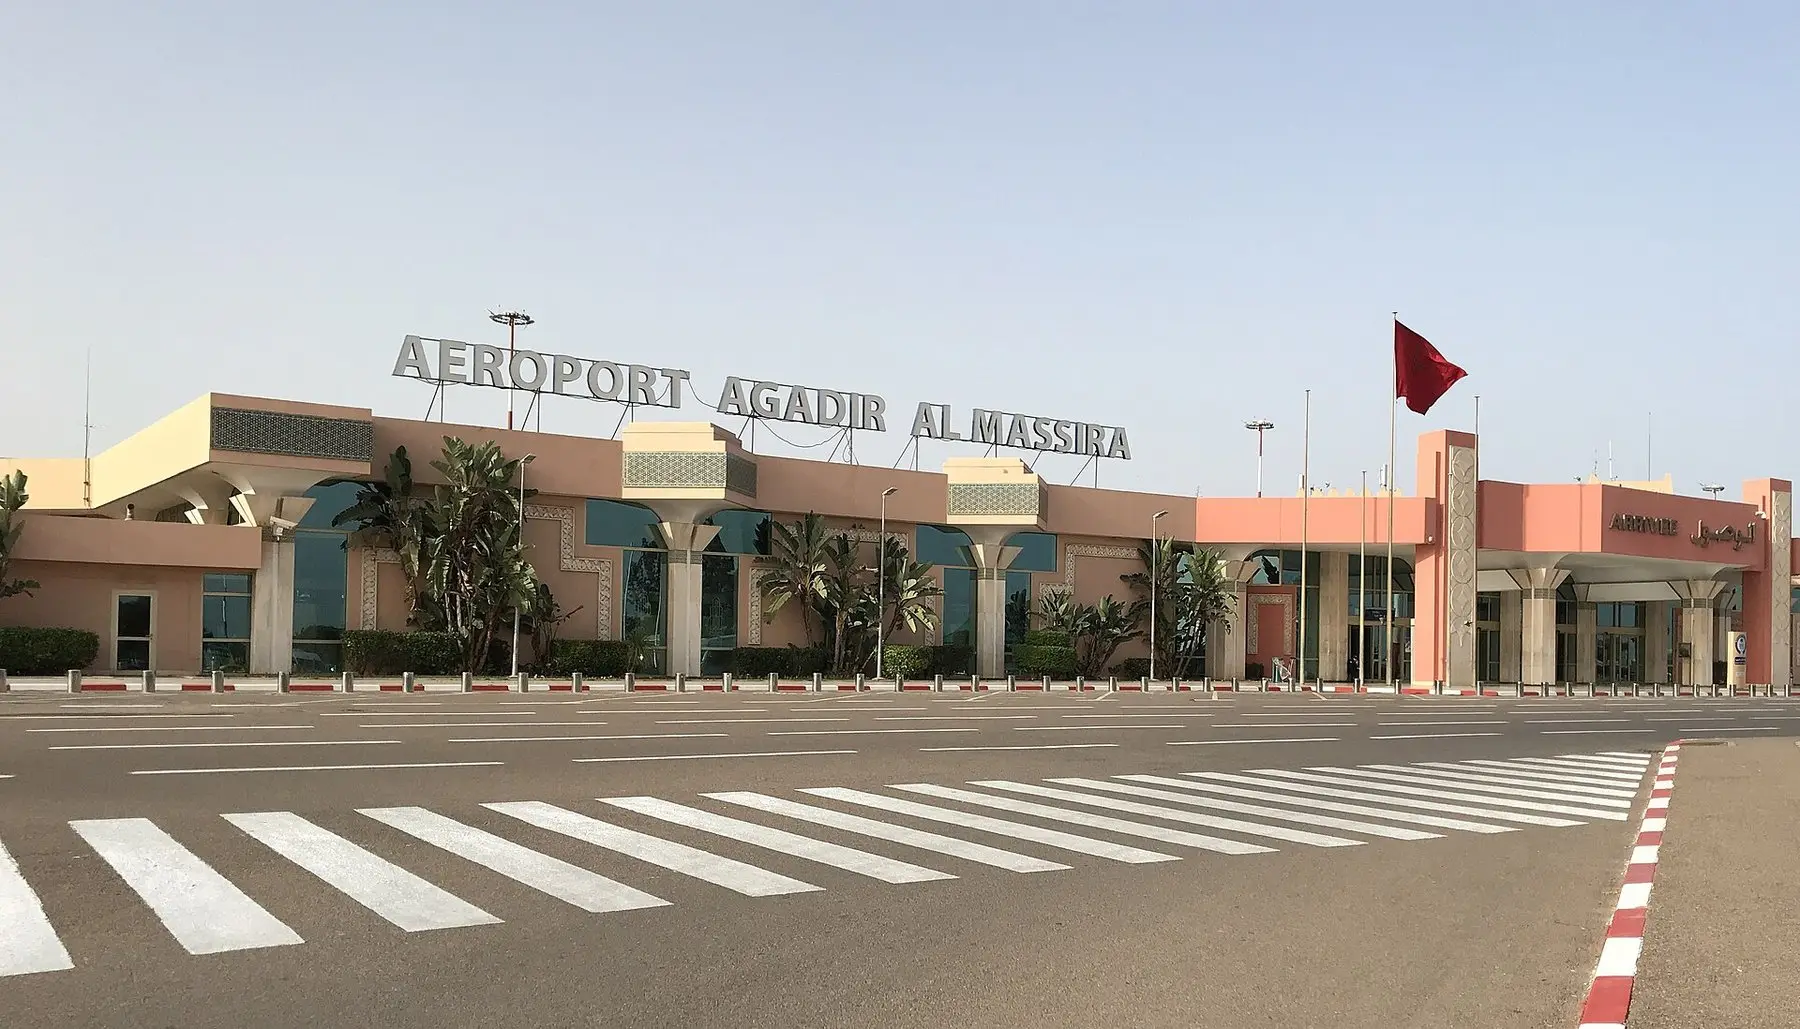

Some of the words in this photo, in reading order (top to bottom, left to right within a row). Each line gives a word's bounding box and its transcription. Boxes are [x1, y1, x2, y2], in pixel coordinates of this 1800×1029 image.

[392, 335, 690, 408] AEROPORT
[717, 376, 886, 432] AGADIR
[911, 402, 961, 439] AL
[971, 408, 1131, 460] MASSIRA
[1690, 519, 1756, 550] الوصول
